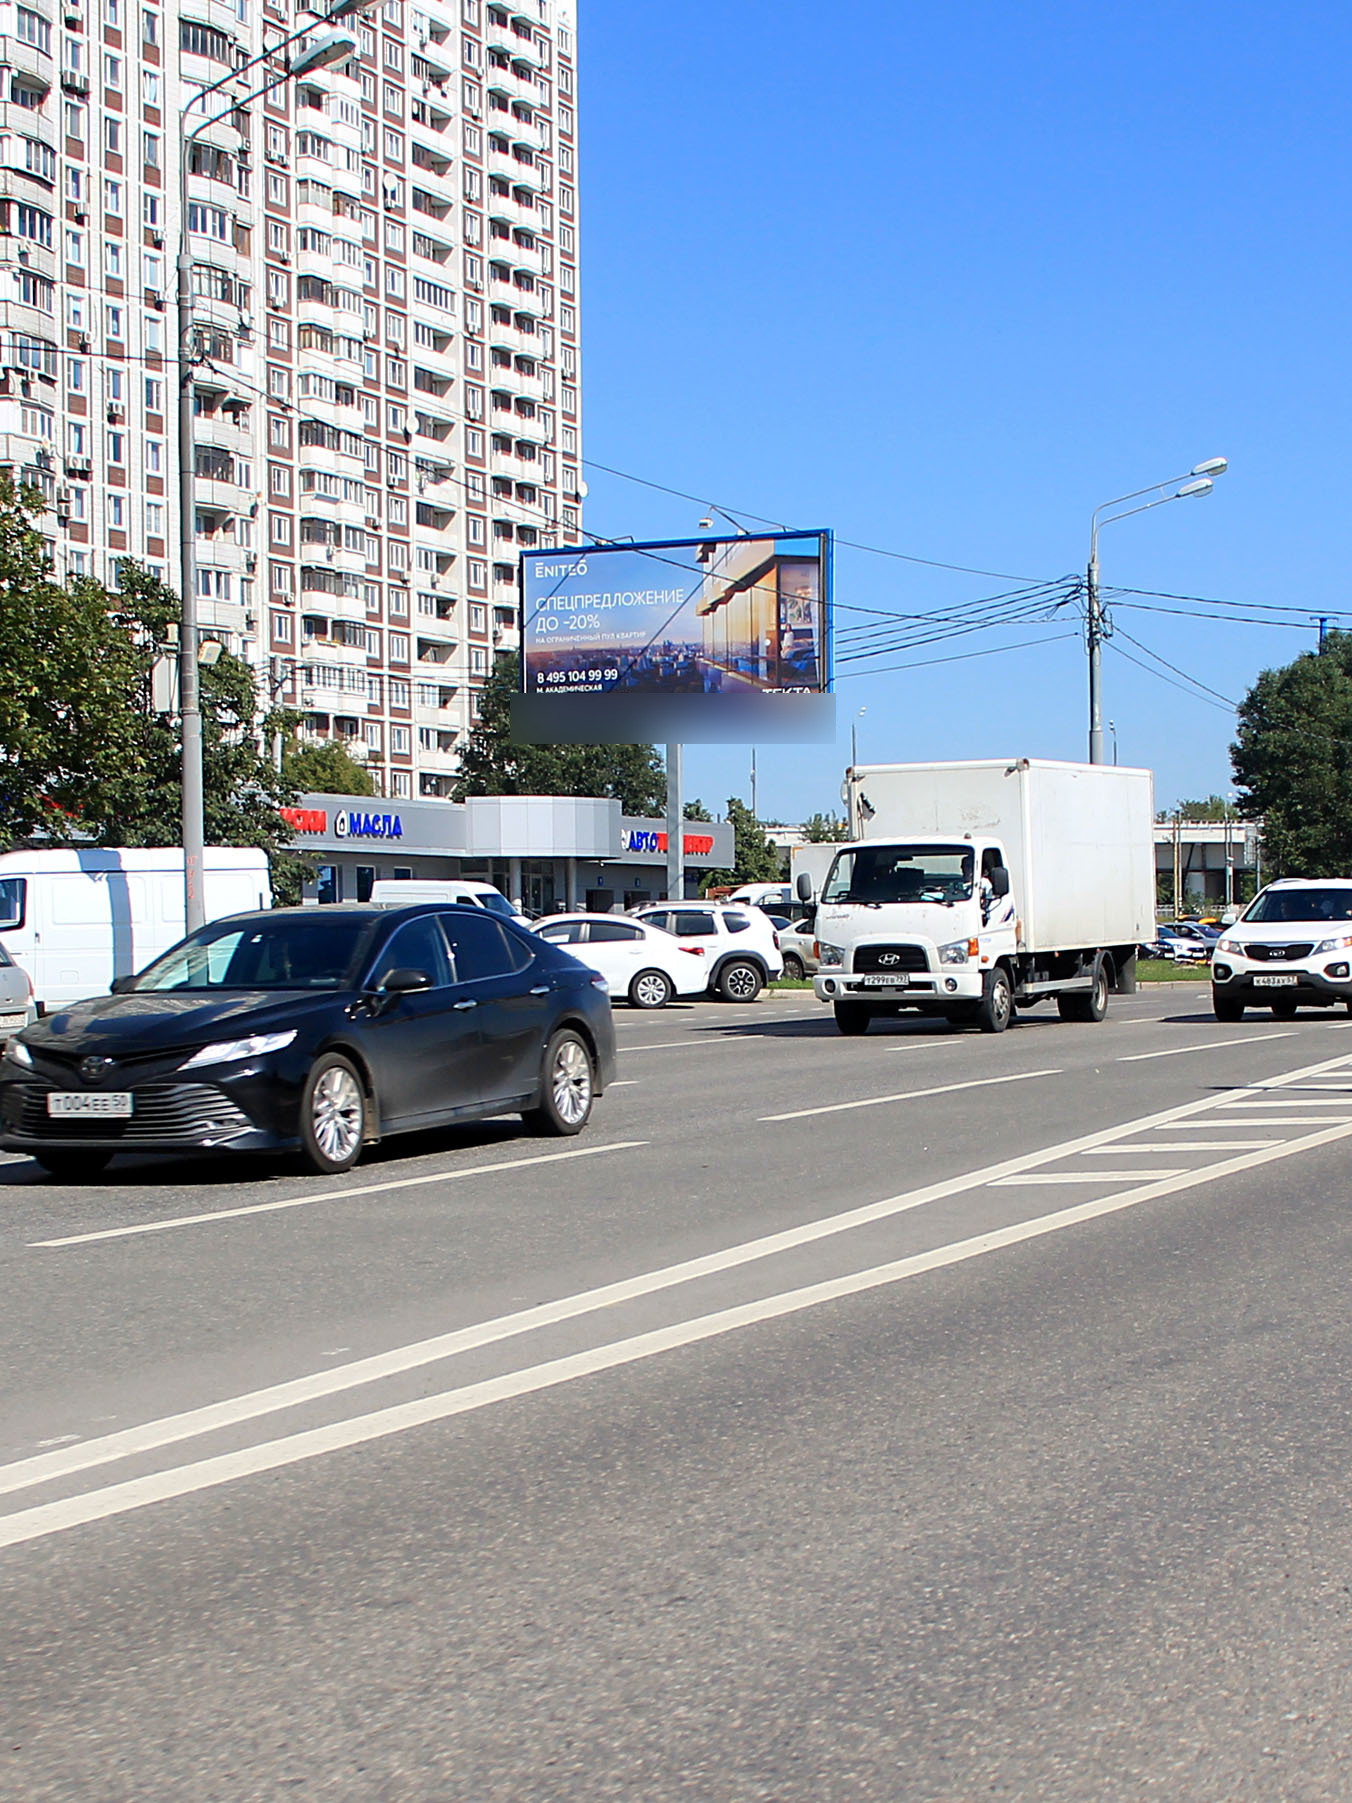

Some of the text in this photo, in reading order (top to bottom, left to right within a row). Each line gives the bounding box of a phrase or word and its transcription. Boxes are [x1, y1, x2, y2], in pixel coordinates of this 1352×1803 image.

[535, 588, 685, 612] СПЕЦПРЕДЛОЖЕНИЕ
[535, 614, 601, 634] ДО -20%
[535, 637, 546, 645] НА
[537, 668, 618, 684] 8 495 104 99 99
[349, 812, 403, 837] МАСЛА
